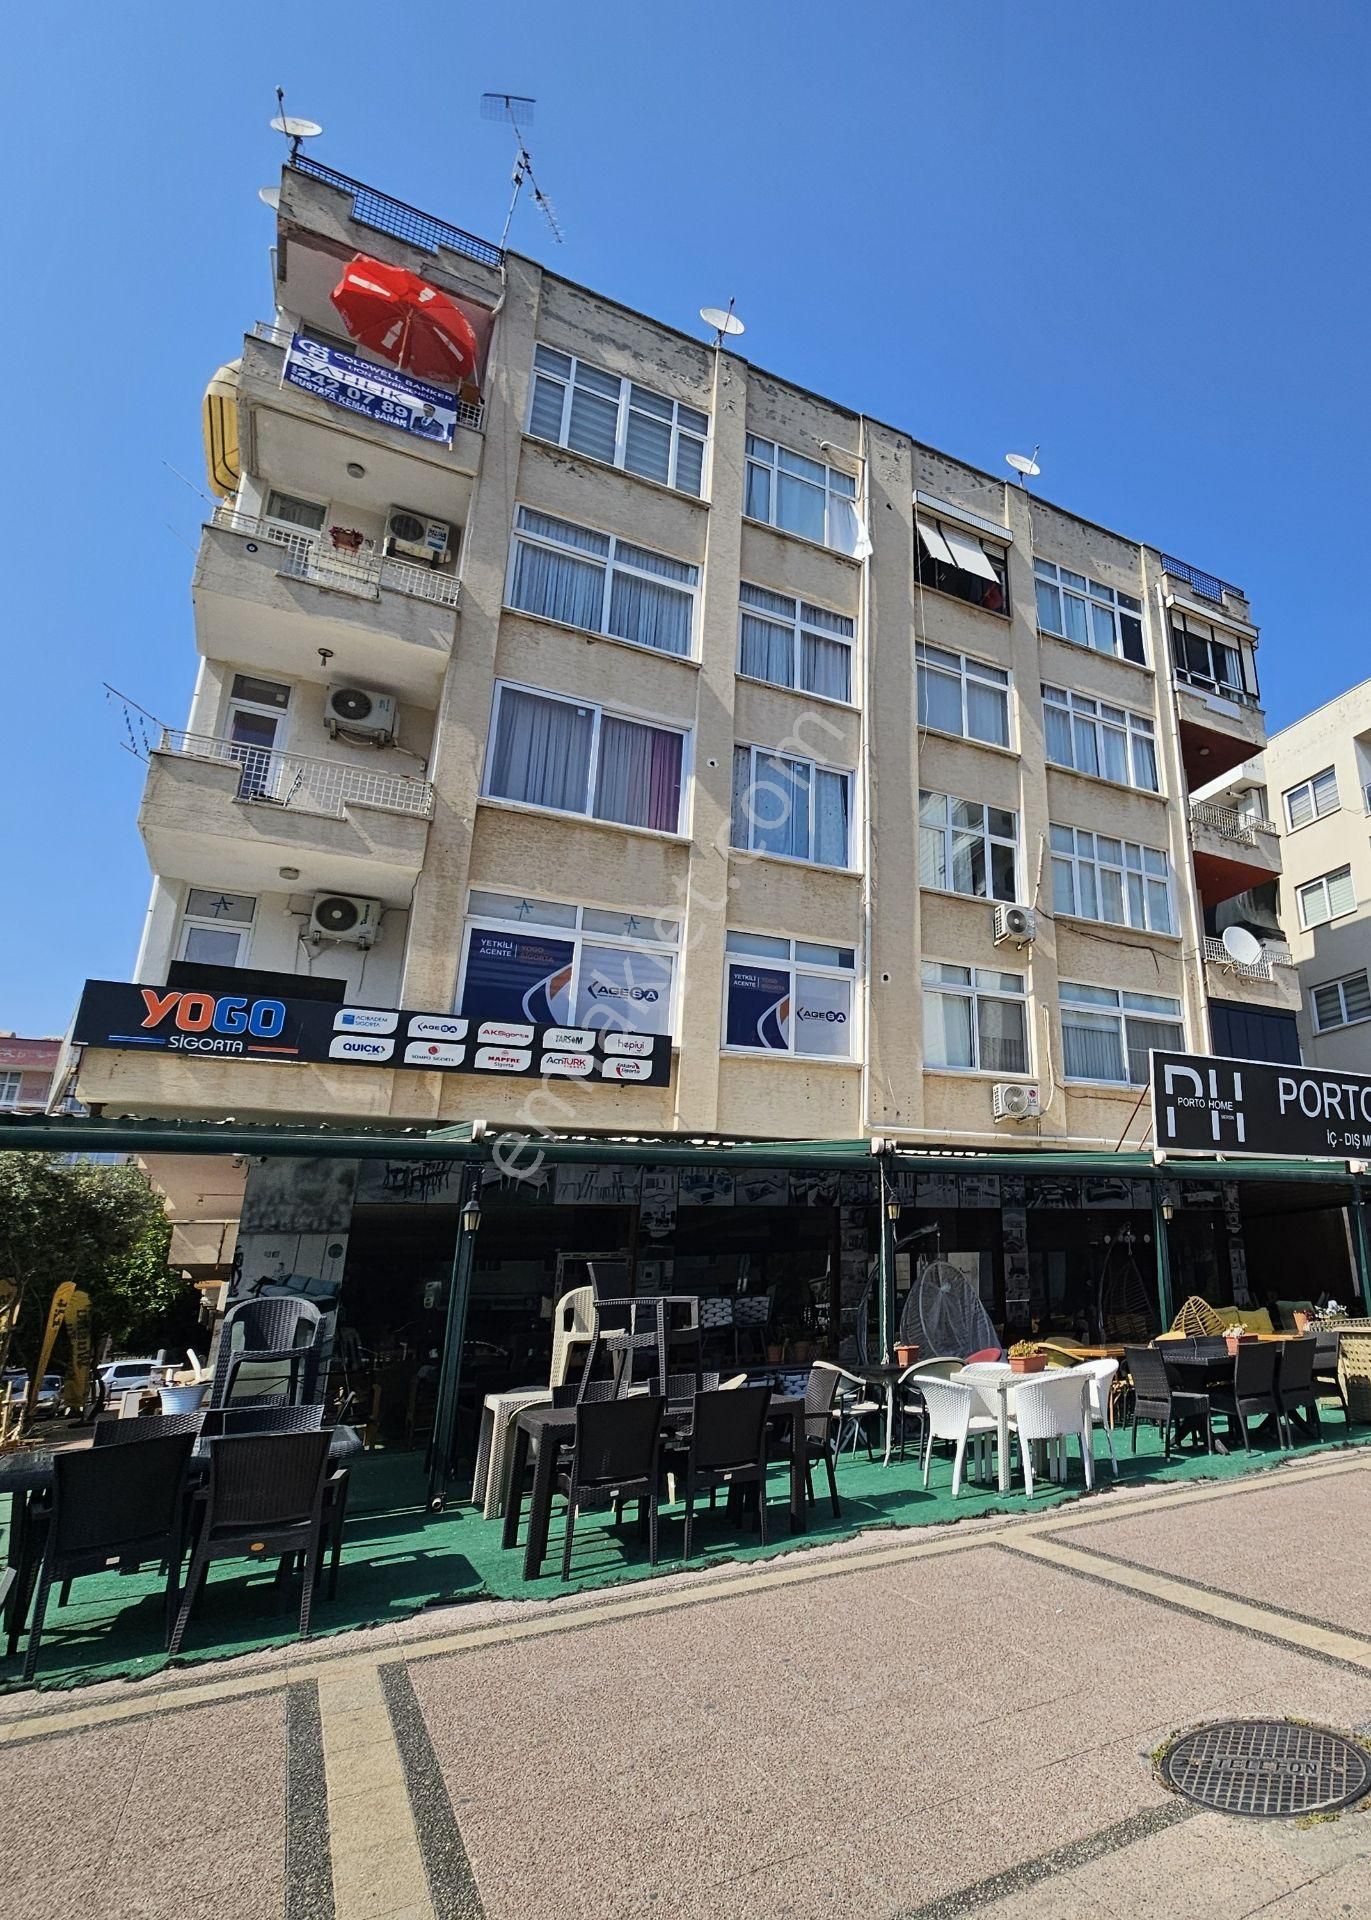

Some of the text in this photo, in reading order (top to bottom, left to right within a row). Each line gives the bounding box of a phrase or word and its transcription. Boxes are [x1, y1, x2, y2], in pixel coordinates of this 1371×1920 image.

[301, 357, 403, 403] SATILIK
[334, 352, 402, 383] COLDWELL
[405, 379, 453, 402] BANKER
[348, 365, 373, 378] LION
[290, 373, 336, 400] MUSTAFA
[338, 394, 372, 416] KEMAL
[296, 367, 340, 393] 242
[347, 387, 376, 405] 07
[381, 400, 408, 418] 89
[481, 938, 513, 949] YETKİLİ
[733, 980, 757, 988] ACENTE
[597, 985, 659, 1002] AGESA
[141, 989, 286, 1038] YOGO
[803, 1010, 847, 1023] AGESA
[168, 1033, 243, 1053] SİGORTA
[343, 1042, 381, 1054] QUICK
[1177, 1096, 1234, 1111] PORTO HOME
[1344, 1132, 1361, 1150] DIŞ
[1216, 1758, 1318, 1775] TELEFON
